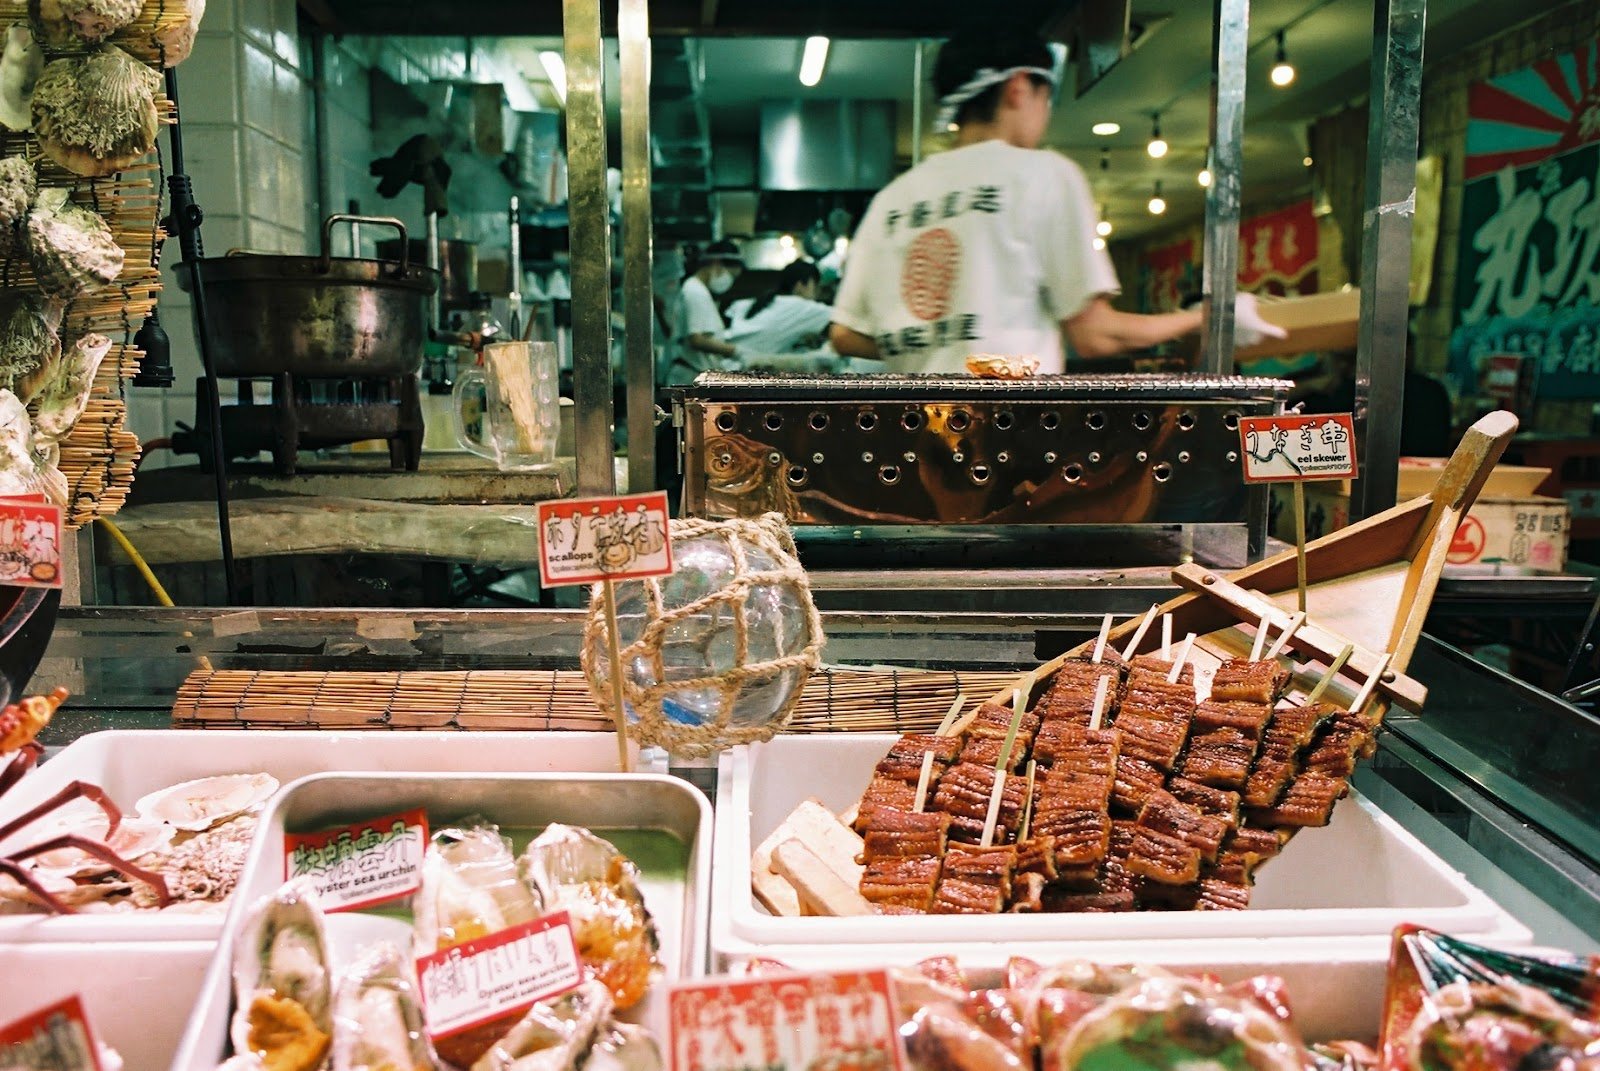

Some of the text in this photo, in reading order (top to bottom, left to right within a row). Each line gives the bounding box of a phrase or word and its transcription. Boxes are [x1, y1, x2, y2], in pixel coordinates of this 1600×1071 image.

[1246, 419, 1348, 456] うなぎ串
[1297, 454, 1347, 463] eel skewer
[549, 552, 594, 562] scallops
[315, 878, 350, 897] yster
[353, 873, 375, 885] sea
[379, 864, 417, 880] urchin
